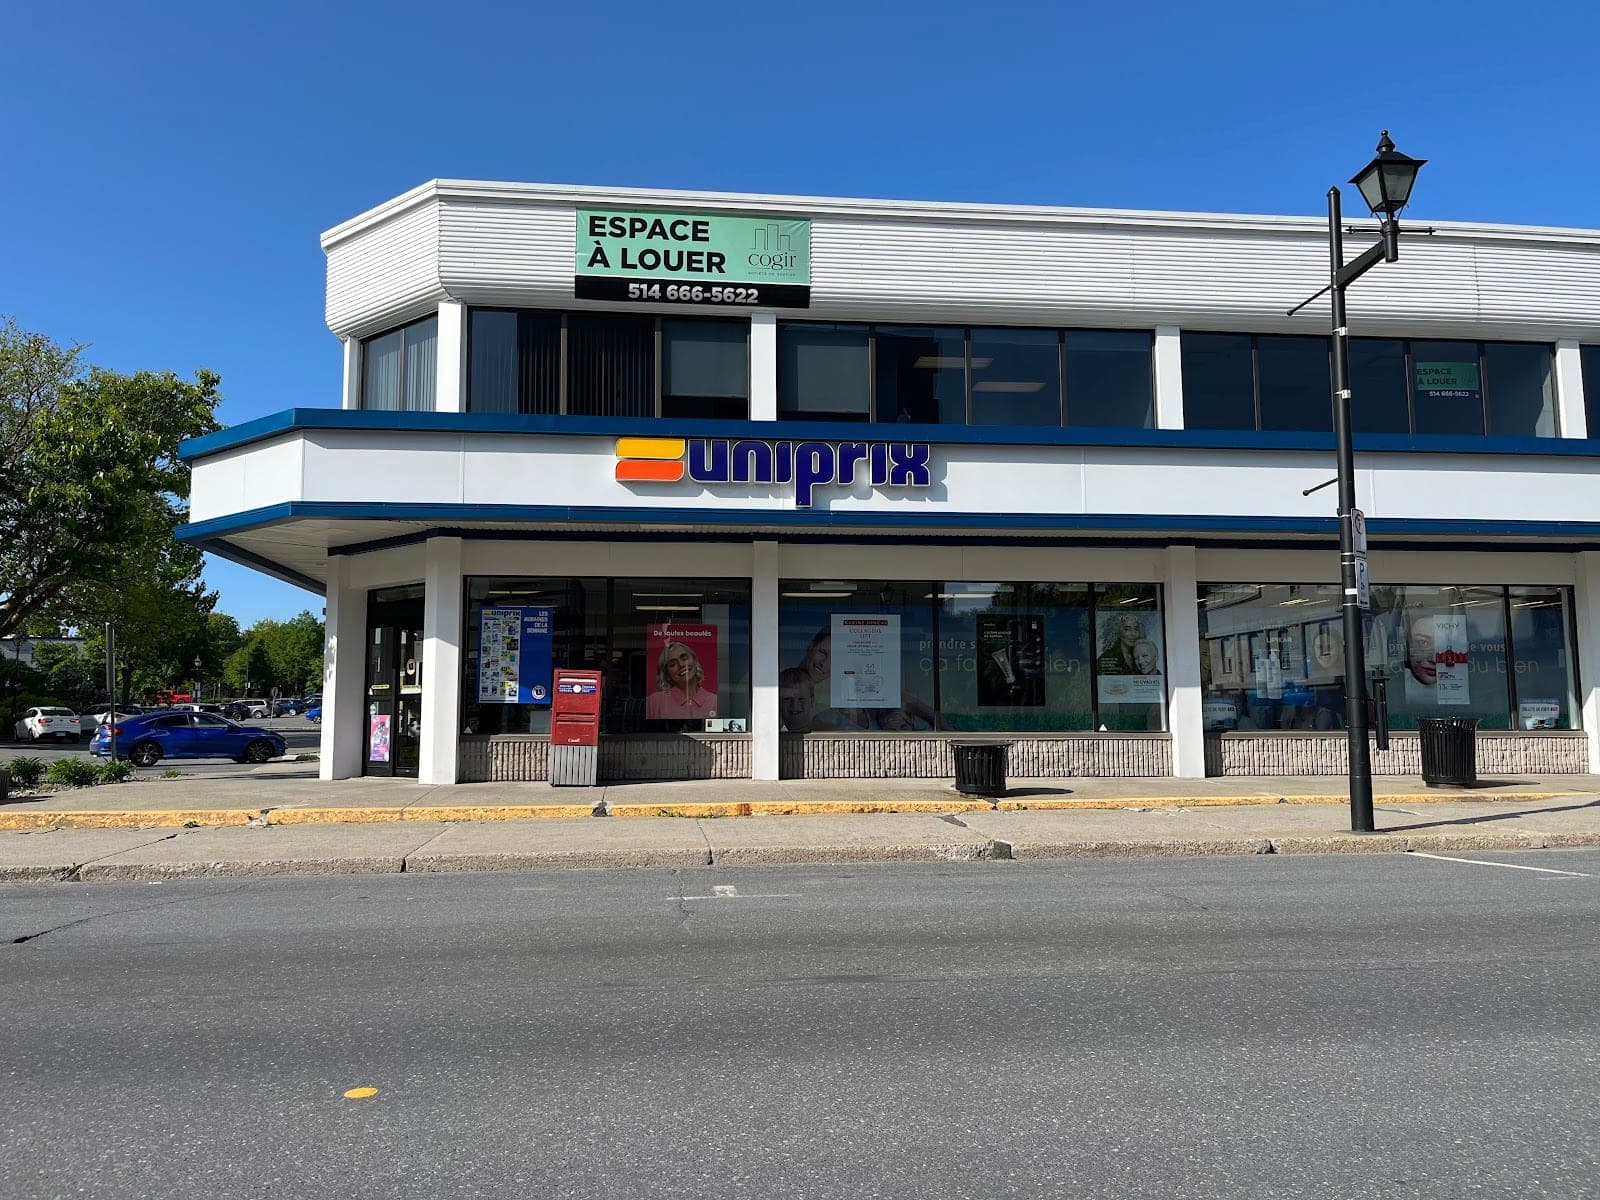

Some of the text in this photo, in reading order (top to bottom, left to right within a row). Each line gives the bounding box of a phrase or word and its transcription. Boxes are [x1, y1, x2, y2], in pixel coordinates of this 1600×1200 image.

[588, 215, 710, 242] ESPACE
[587, 240, 726, 274] À LOUER
[748, 252, 797, 271] cogir
[628, 283, 759, 304] 514 666-5622
[688, 438, 931, 507] uniprix
[919, 638, 970, 650] prndre
[1496, 656, 1540, 673] ben
